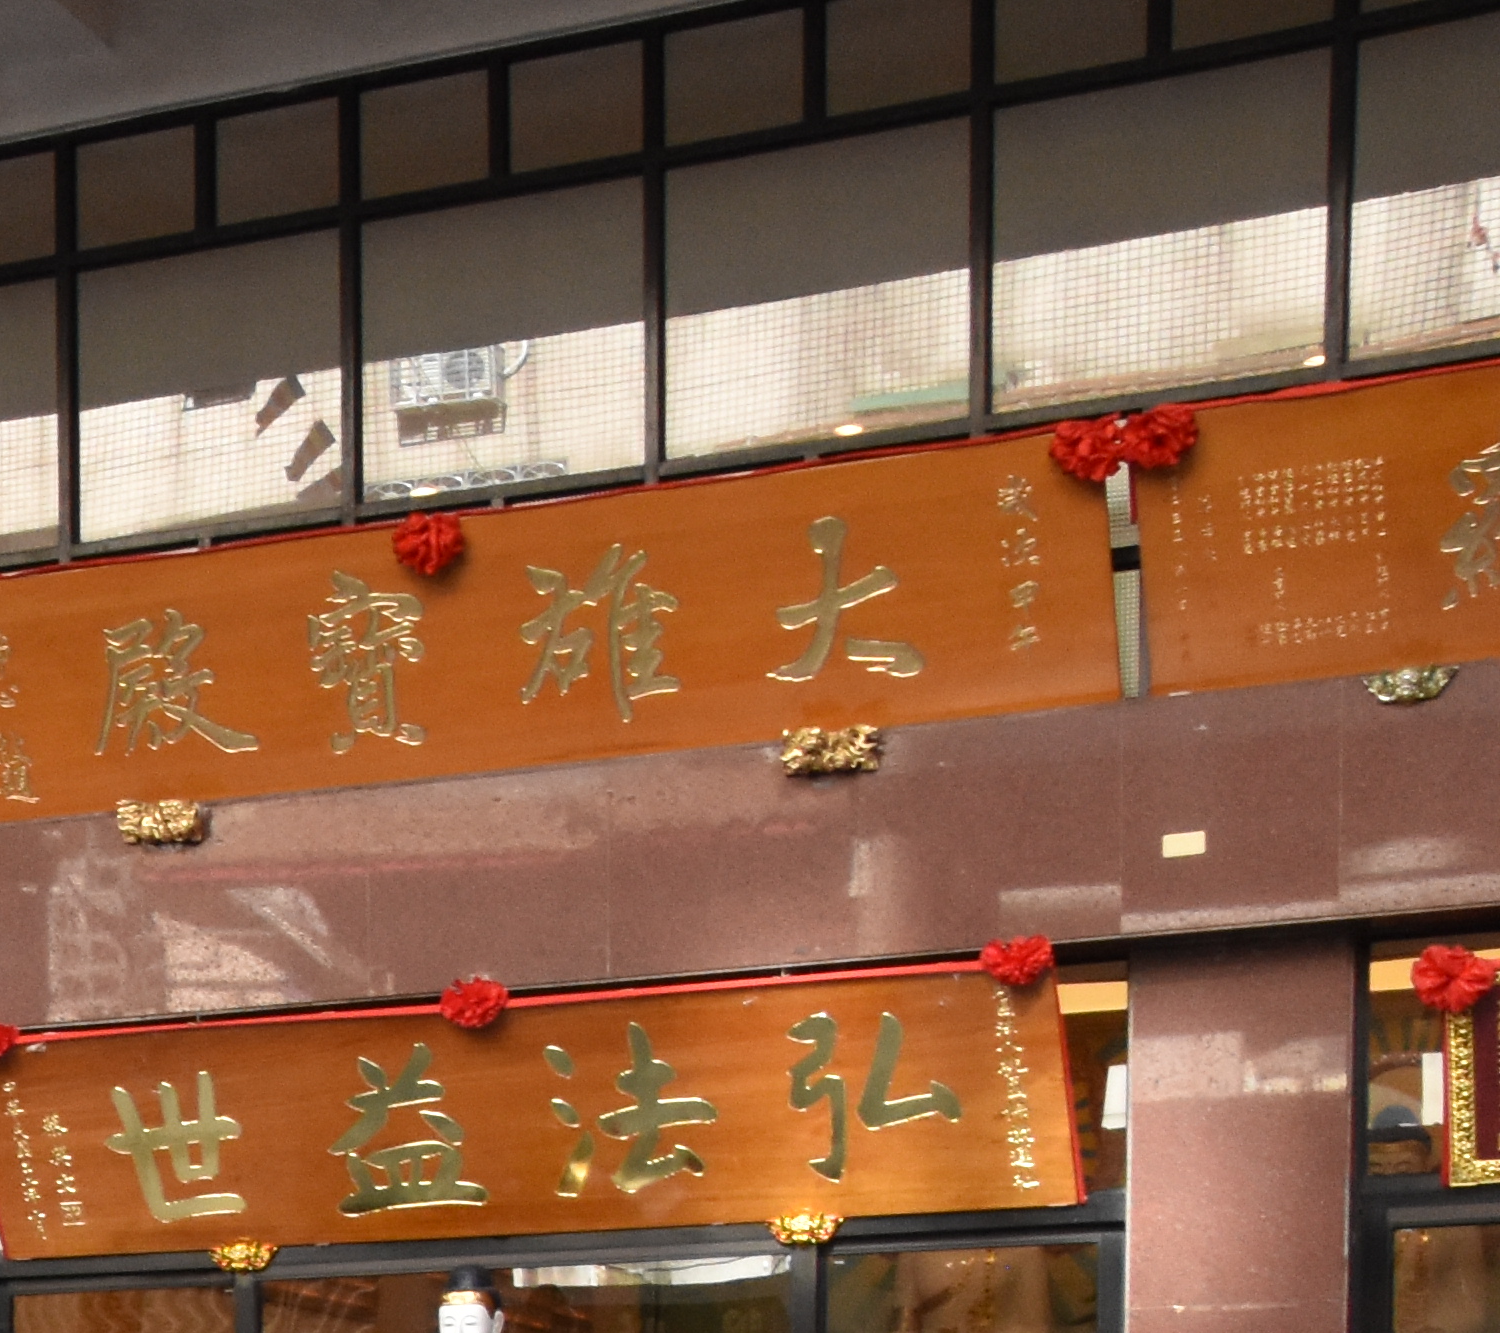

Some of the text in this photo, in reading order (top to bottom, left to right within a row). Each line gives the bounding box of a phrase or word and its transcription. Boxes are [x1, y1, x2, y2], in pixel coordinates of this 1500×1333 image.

[94, 516, 925, 757] 大雄寶殿
[104, 1010, 962, 1223] 弘法益世
